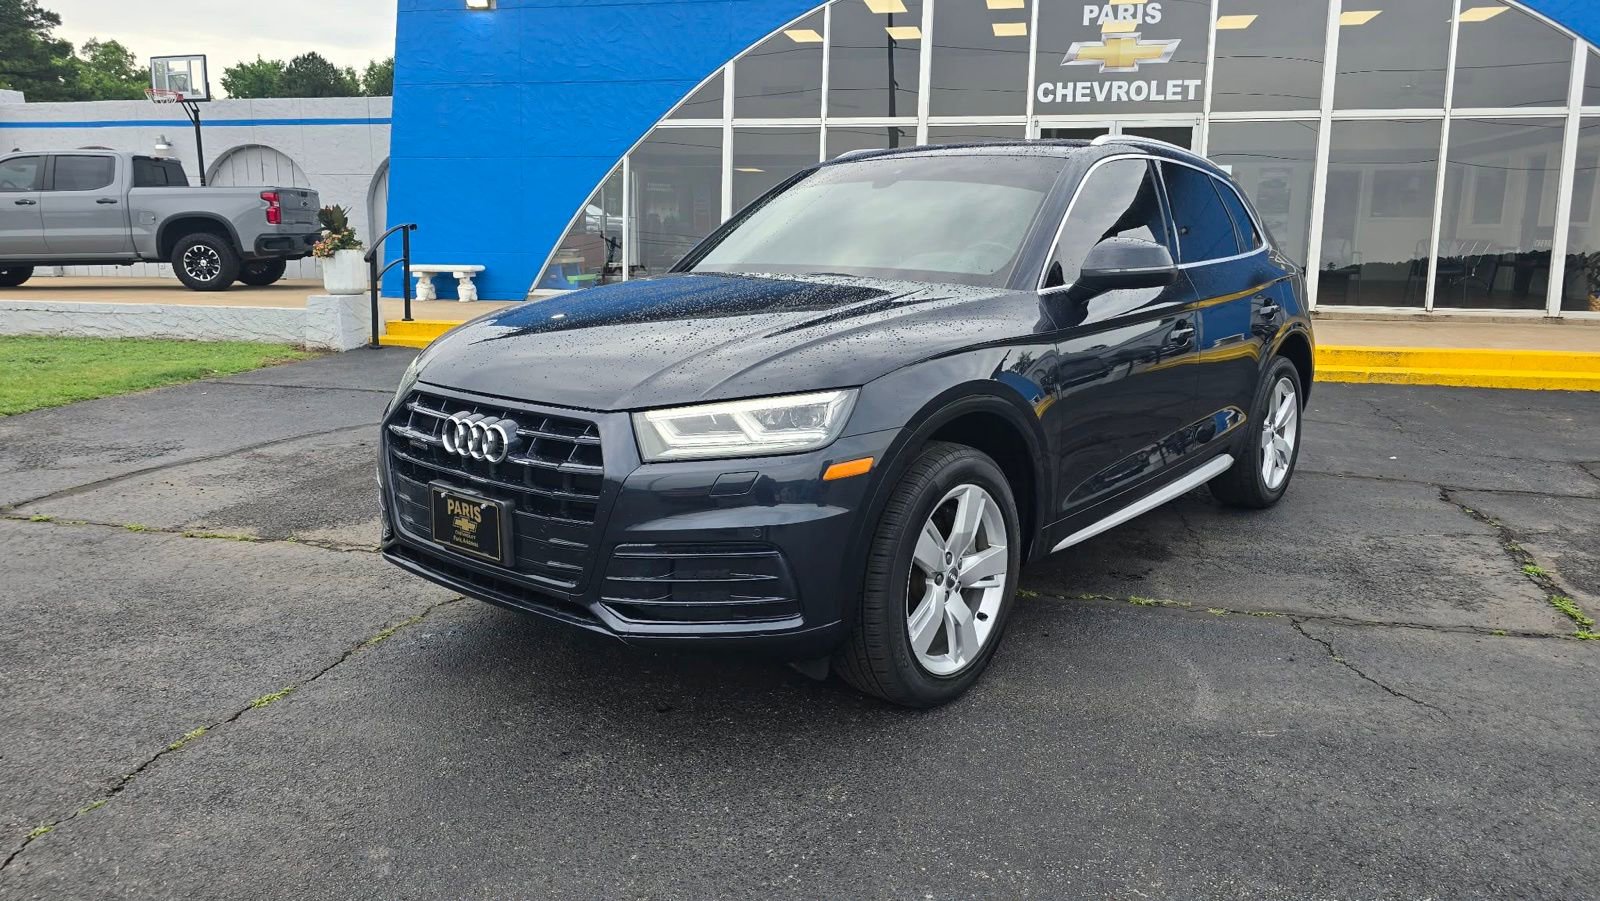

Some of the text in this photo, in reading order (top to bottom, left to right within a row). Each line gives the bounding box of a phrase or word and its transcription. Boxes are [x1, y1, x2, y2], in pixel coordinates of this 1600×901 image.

[1082, 3, 1162, 26] PARIS
[1037, 79, 1202, 103] CHEVROLET
[447, 499, 482, 523] PARIS
